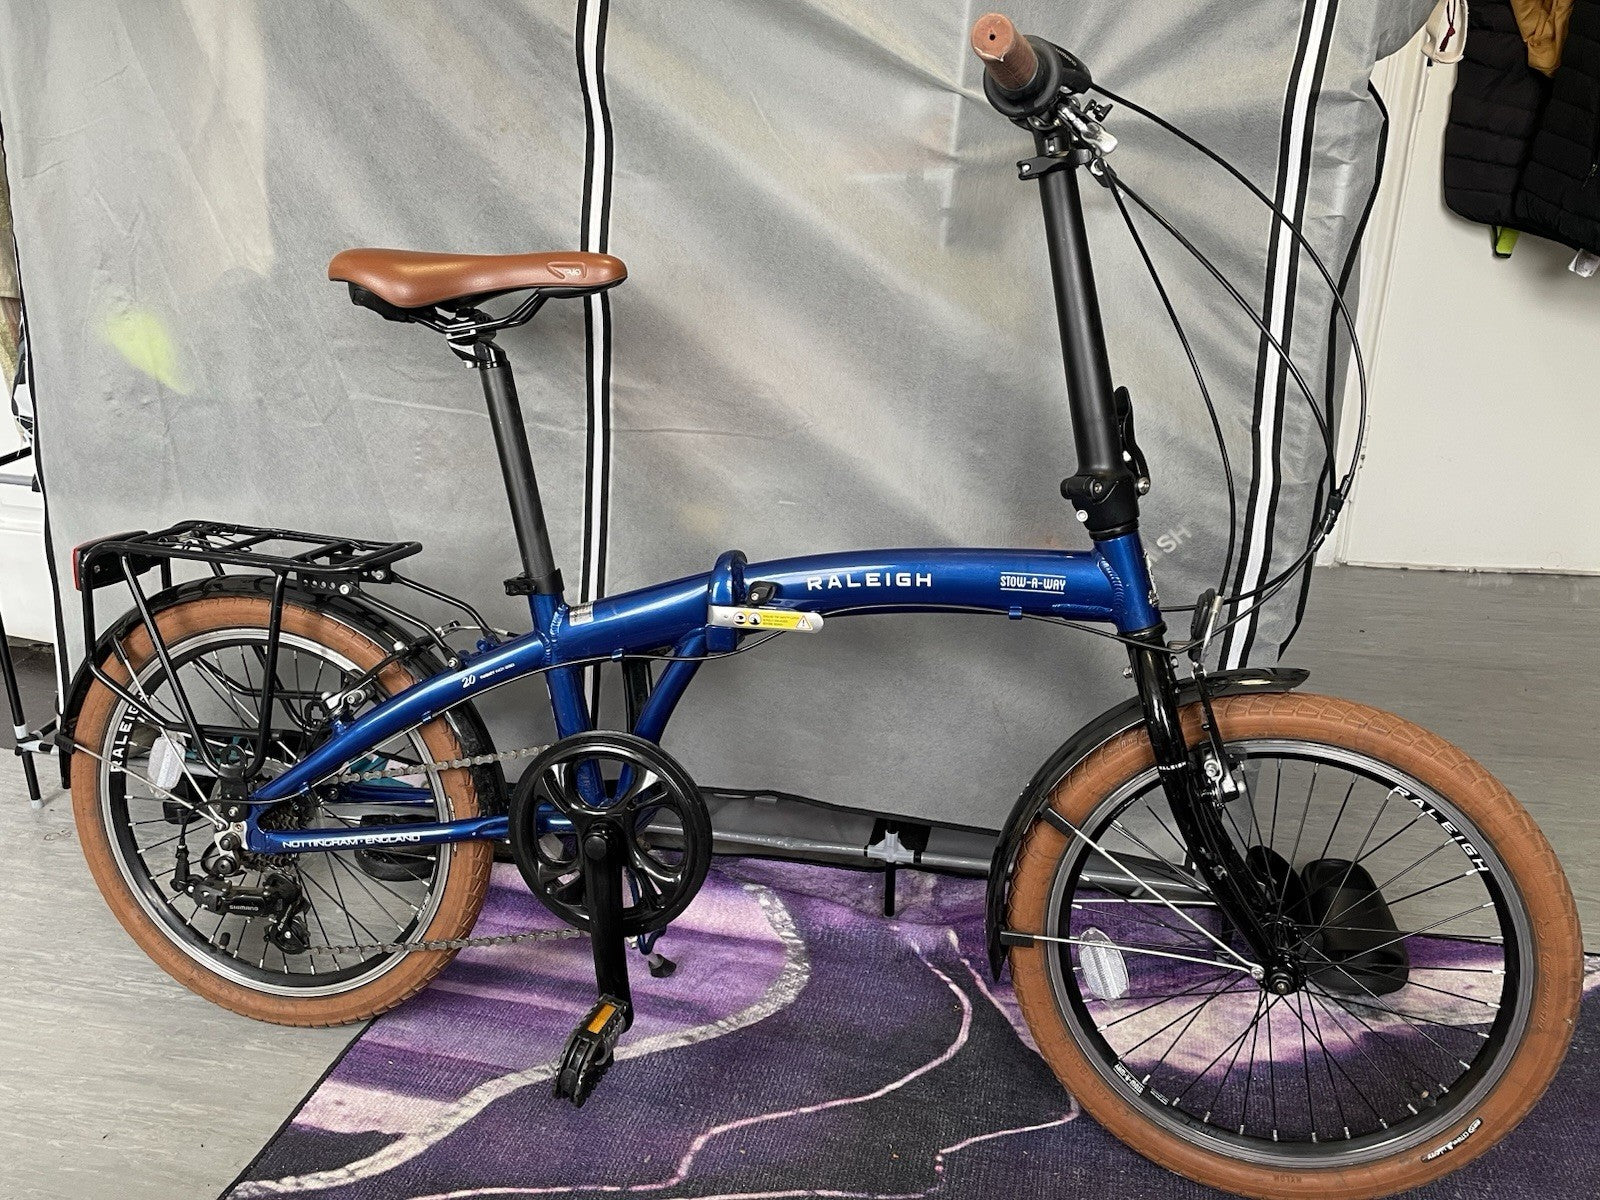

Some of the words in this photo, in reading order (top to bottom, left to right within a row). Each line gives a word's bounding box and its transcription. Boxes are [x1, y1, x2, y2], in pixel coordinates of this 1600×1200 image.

[806, 572, 932, 591] RALEIGH
[1000, 574, 1066, 592] STOW-A-WAY
[1393, 785, 1490, 872] RALEIGH
[282, 839, 359, 849] NOTTINGHAM
[366, 834, 421, 845] ENGLAND
